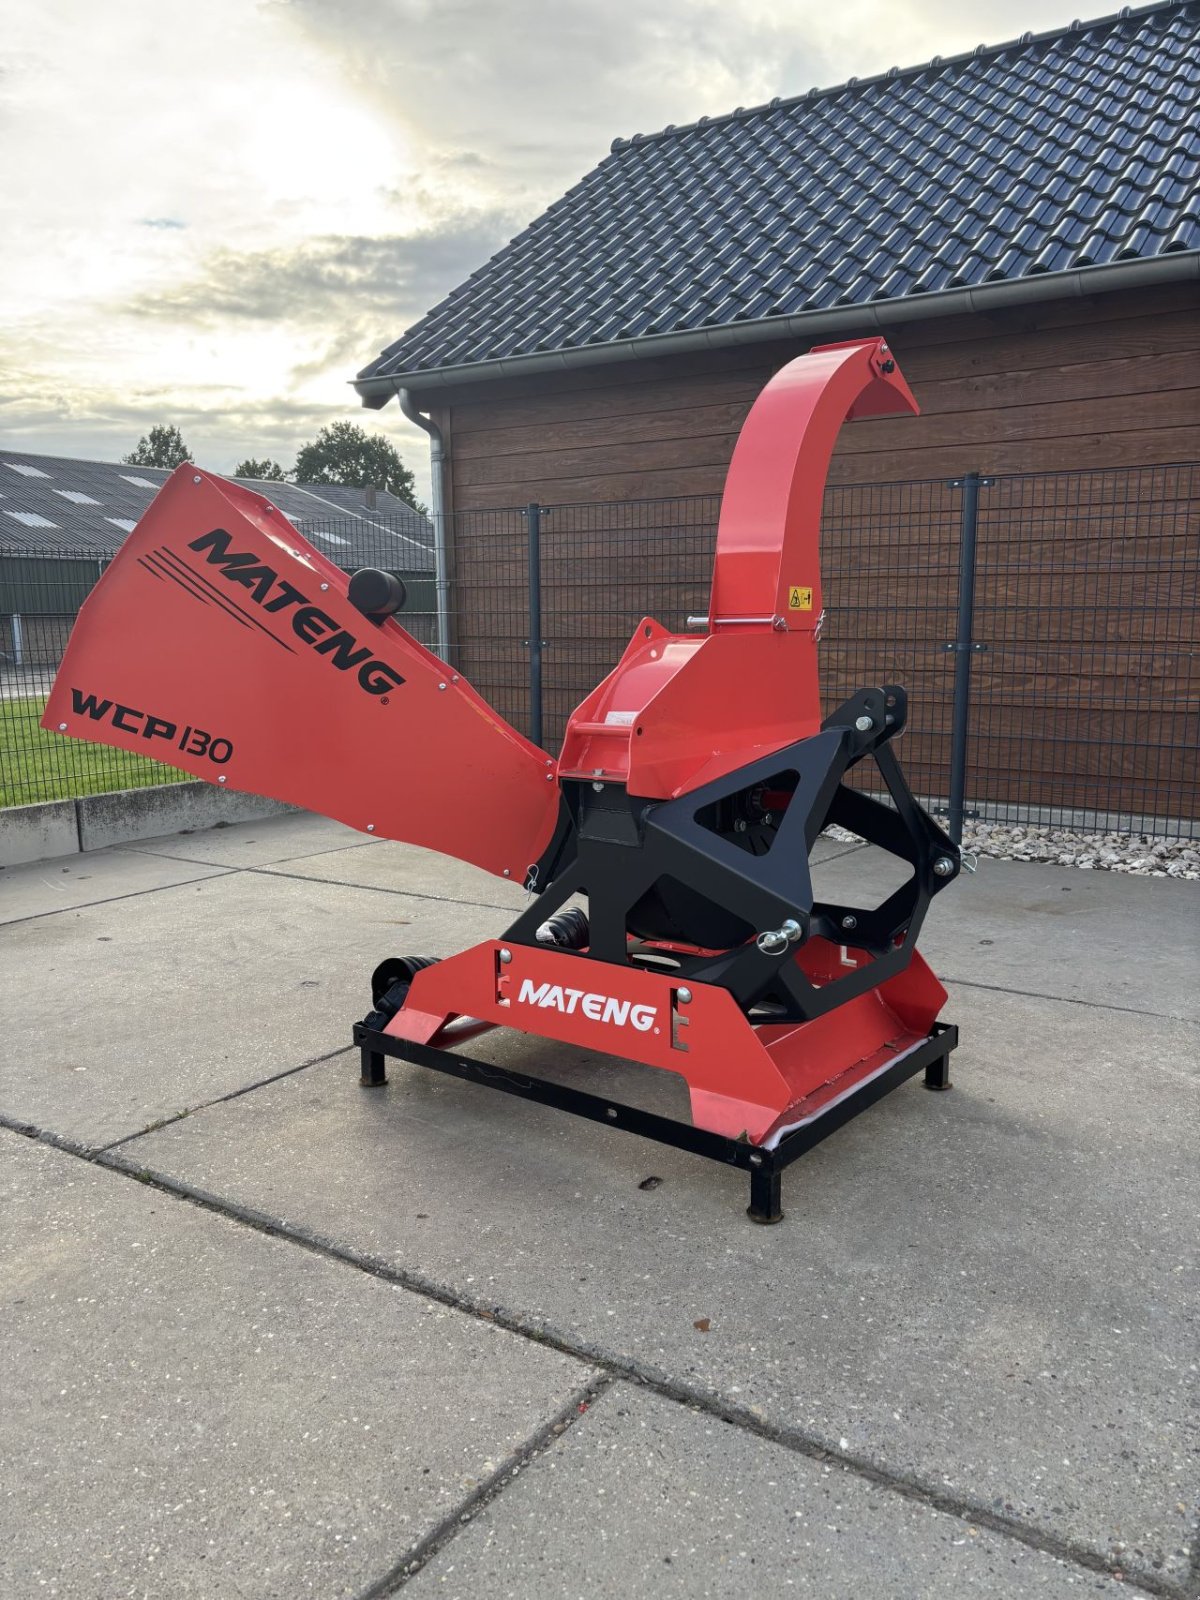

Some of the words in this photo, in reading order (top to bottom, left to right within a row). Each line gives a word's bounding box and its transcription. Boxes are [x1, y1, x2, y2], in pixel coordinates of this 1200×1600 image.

[187, 528, 407, 696] MATENG
[71, 687, 177, 740] WCP
[178, 726, 234, 764] 130
[518, 979, 658, 1032] MATENG
